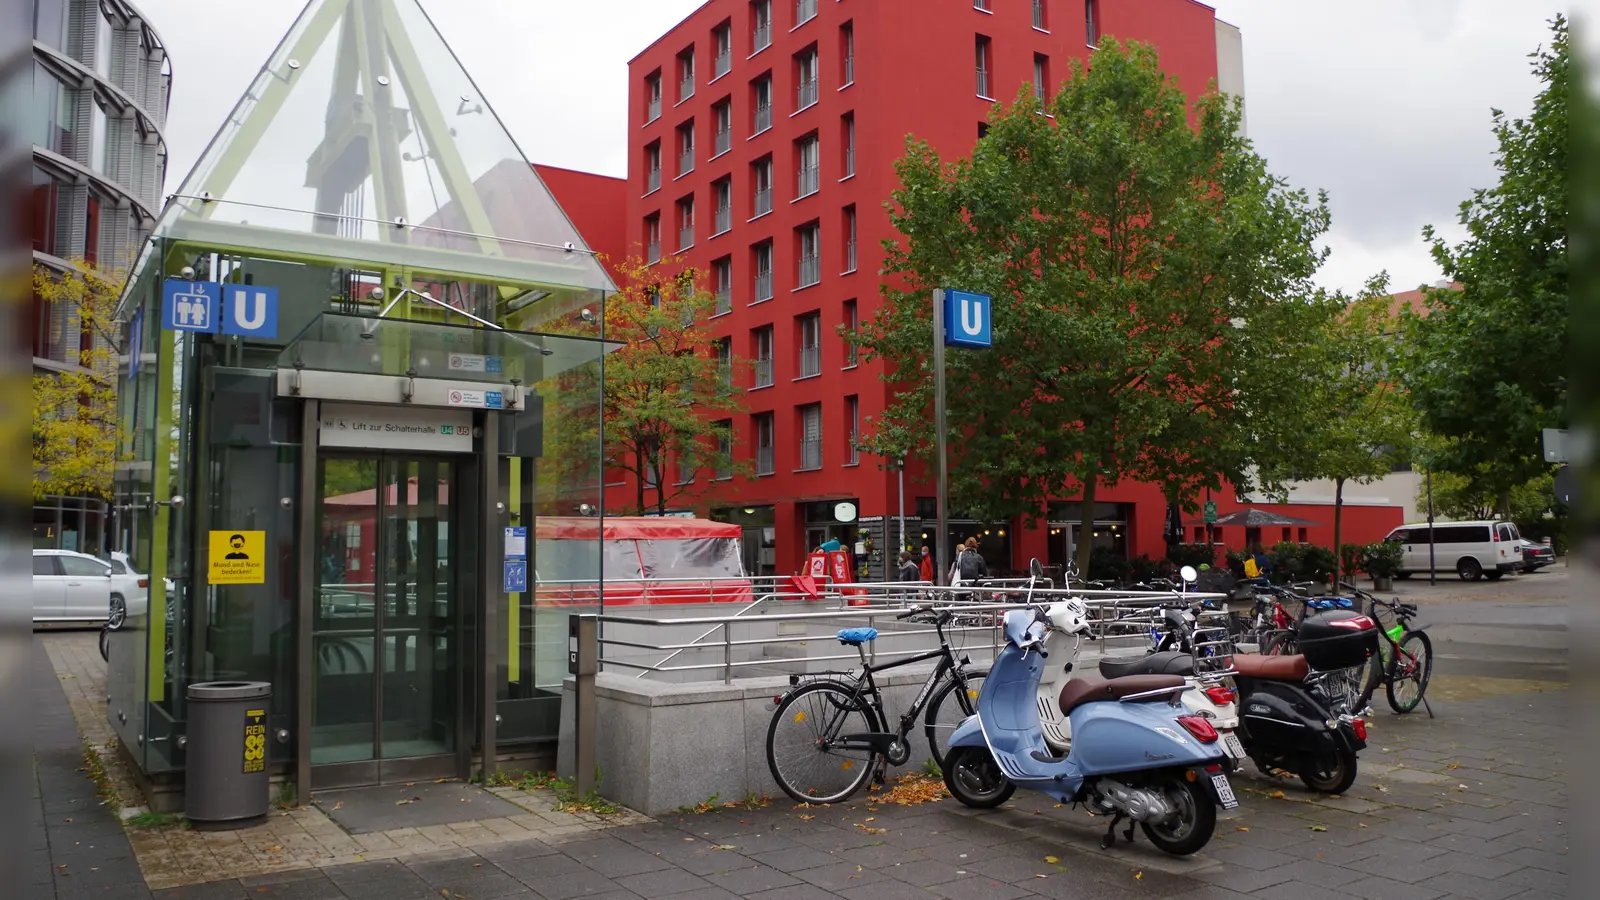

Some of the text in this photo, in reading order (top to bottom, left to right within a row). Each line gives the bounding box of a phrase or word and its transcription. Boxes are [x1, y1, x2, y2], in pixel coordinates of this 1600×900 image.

[234, 290, 266, 330] U
[961, 299, 982, 336] U
[352, 422, 367, 431] Lift
[385, 423, 436, 434] Schalterhalle
[441, 425, 453, 435] U4
[457, 426, 469, 435] U5
[246, 724, 265, 735] REIN
